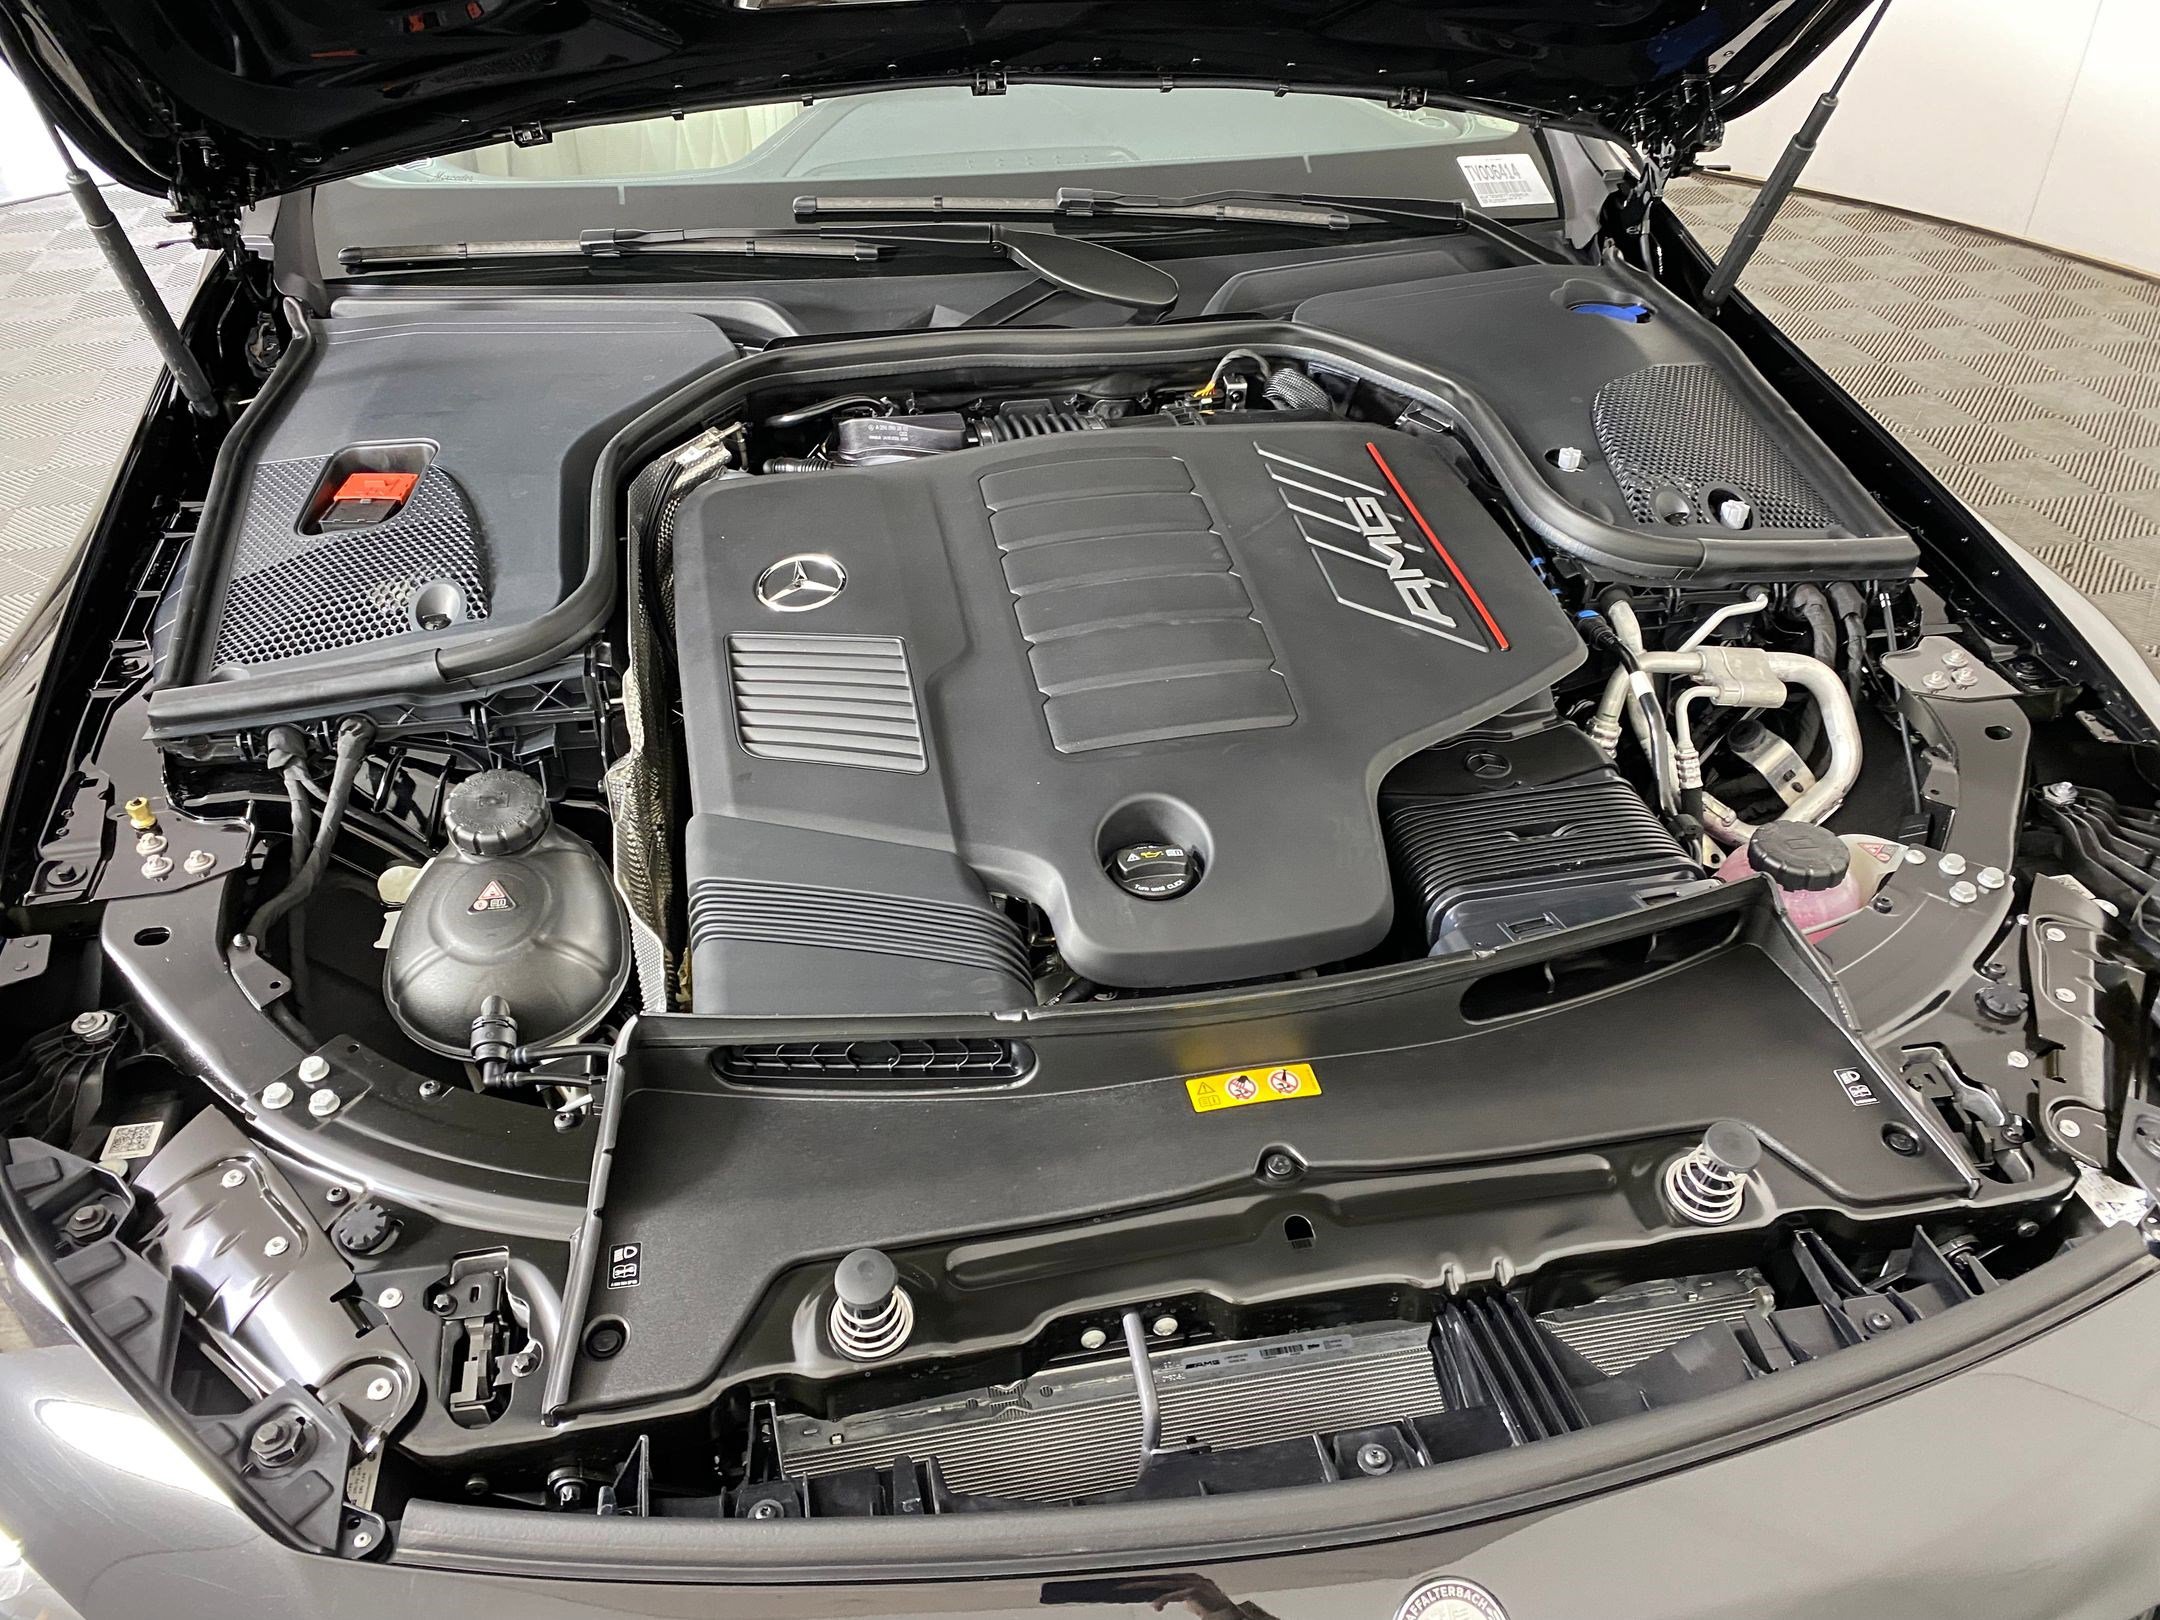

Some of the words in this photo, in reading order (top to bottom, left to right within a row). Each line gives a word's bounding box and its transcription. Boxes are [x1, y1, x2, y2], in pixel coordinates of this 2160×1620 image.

[1464, 163, 1521, 182] TV006414
[1343, 496, 1457, 629] AMG
[1134, 883, 1150, 892] Turn
[1166, 879, 1185, 890] CLICK
[1192, 1358, 1221, 1369] AMG
[1404, 1585, 1488, 1620] AFFALTERBACH
